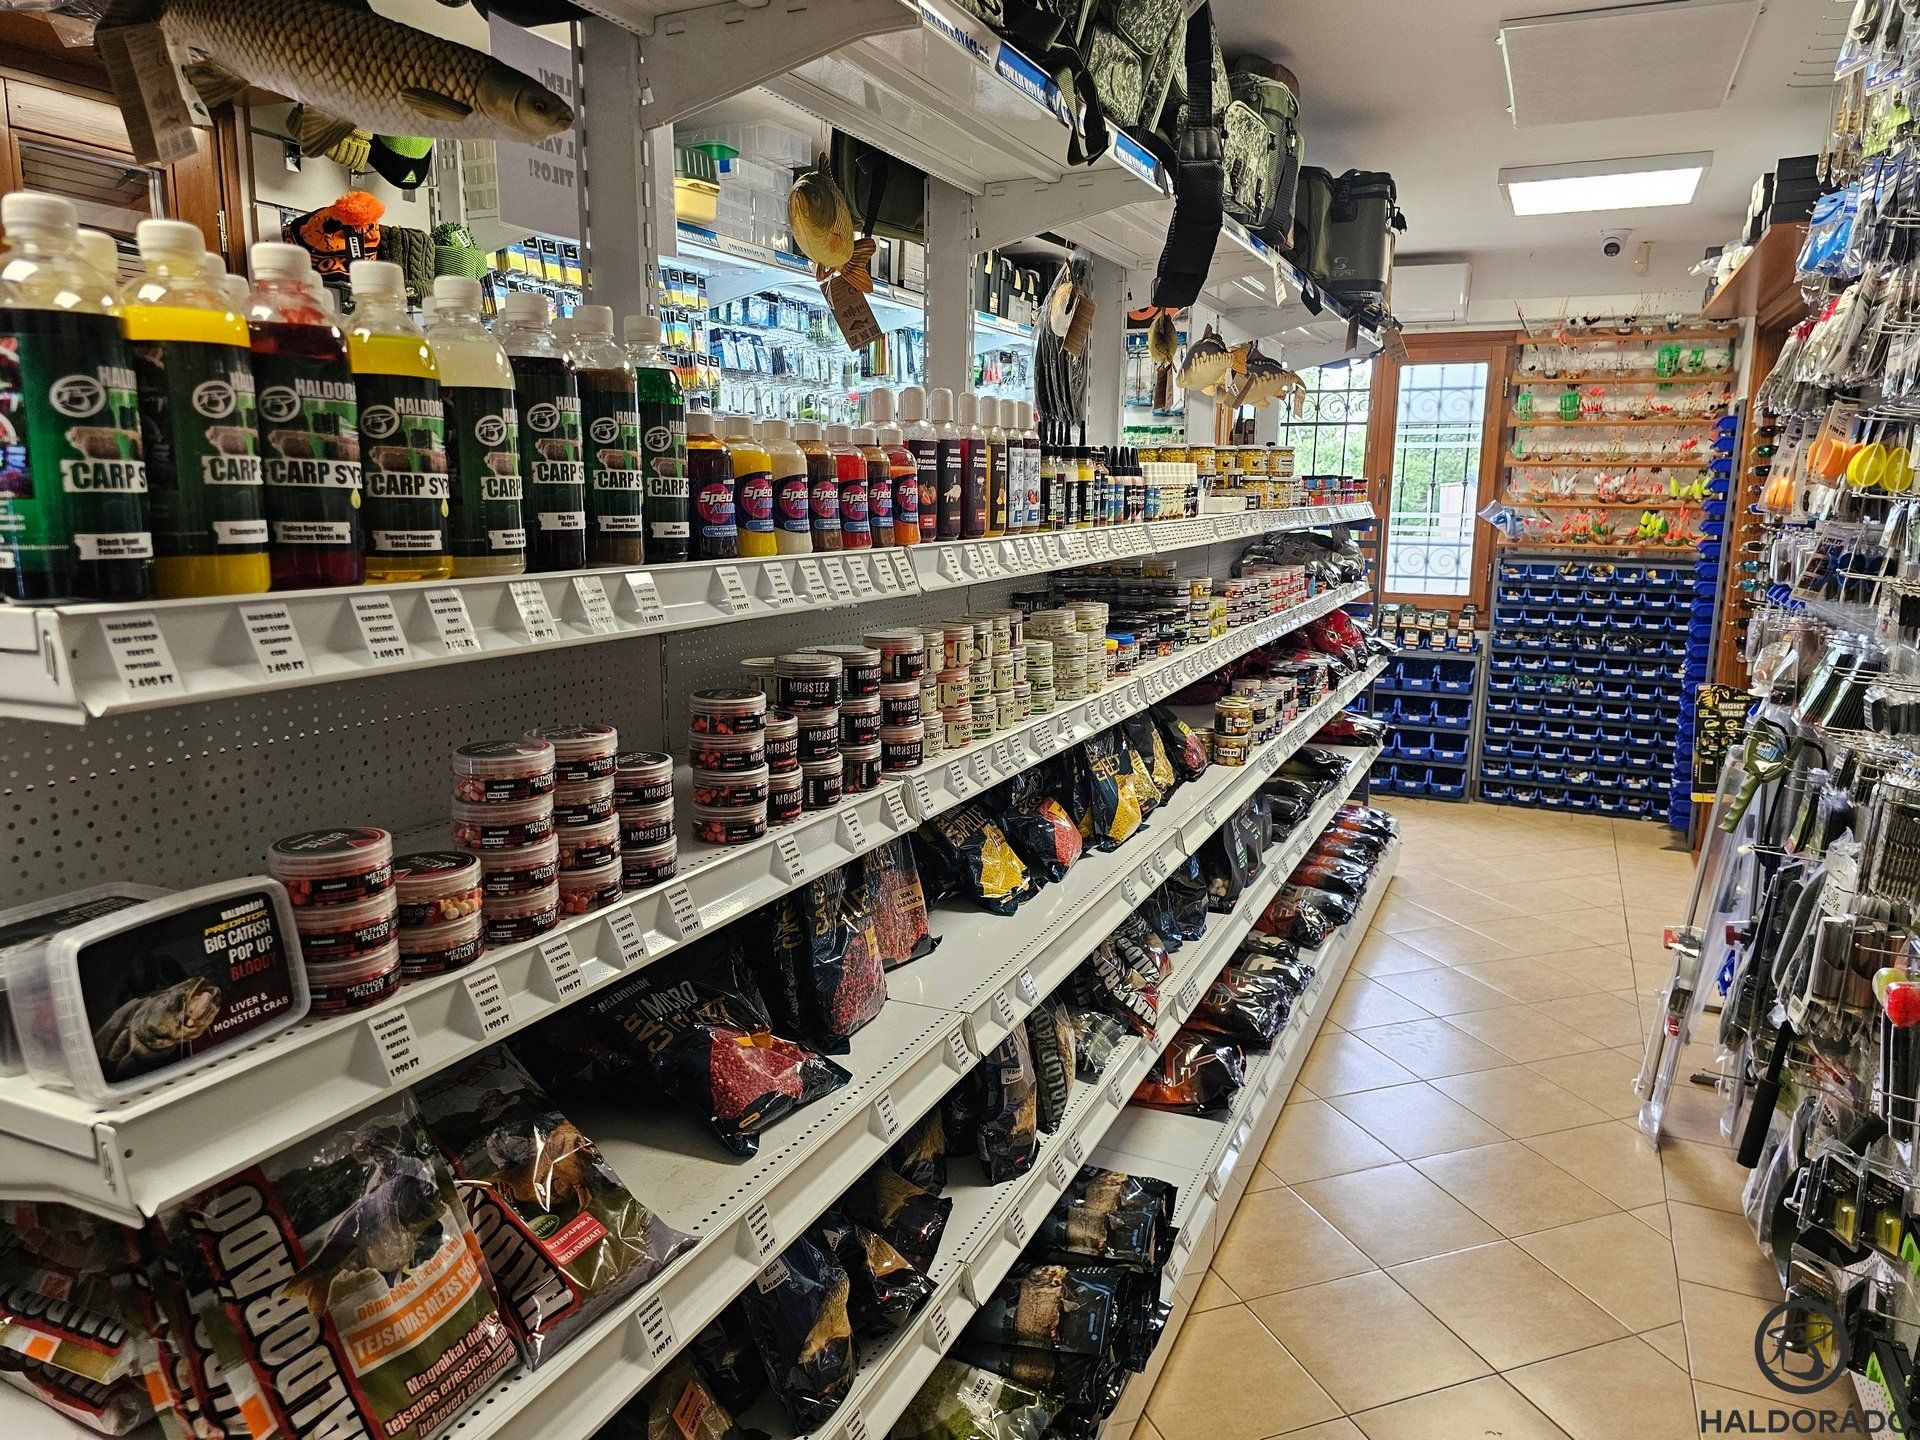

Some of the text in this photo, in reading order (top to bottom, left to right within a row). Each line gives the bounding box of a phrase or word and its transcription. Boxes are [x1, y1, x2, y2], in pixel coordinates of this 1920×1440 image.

[72, 462, 135, 489] CARP
[209, 458, 256, 481] CARP
[269, 461, 330, 484] CARP
[537, 463, 577, 483] CARP
[371, 474, 426, 496] CARP
[486, 476, 522, 499] CARP
[597, 471, 637, 489] CARP
[651, 479, 685, 496] CARP
[395, 648, 405, 658] FT
[293, 660, 305, 670] FT
[159, 674, 175, 685] FT
[790, 682, 830, 693] MONSTER
[631, 826, 667, 841] MONSTER
[204, 909, 269, 936] PREDATOR
[355, 922, 389, 938] METHOD
[204, 918, 271, 954] BIG CATFISH
[362, 929, 389, 943] PELLET
[228, 936, 274, 964] POP UP
[445, 942, 475, 958] METHOD
[451, 949, 475, 962] PELLET
[638, 947, 645, 956] FT
[230, 951, 277, 981] BLOODY
[347, 977, 385, 995] METHOD
[354, 984, 385, 999] PELLET
[563, 983, 573, 994] 990
[573, 979, 582, 990] FT
[230, 992, 268, 1014] LIVER &
[641, 980, 698, 1018] MICRO
[213, 996, 289, 1033] MONSTER CRAB
[489, 1019, 500, 1030] 990
[501, 1014, 510, 1025] FT
[396, 1063, 408, 1076] 990
[410, 1057, 419, 1070] FT
[352, 1307, 429, 1361] TEJSAVAS
[429, 1276, 463, 1318] MÉZES
[665, 1336, 673, 1347] FT
[406, 1344, 467, 1395] Magvakkal
[385, 1390, 440, 1438] tejsavas
